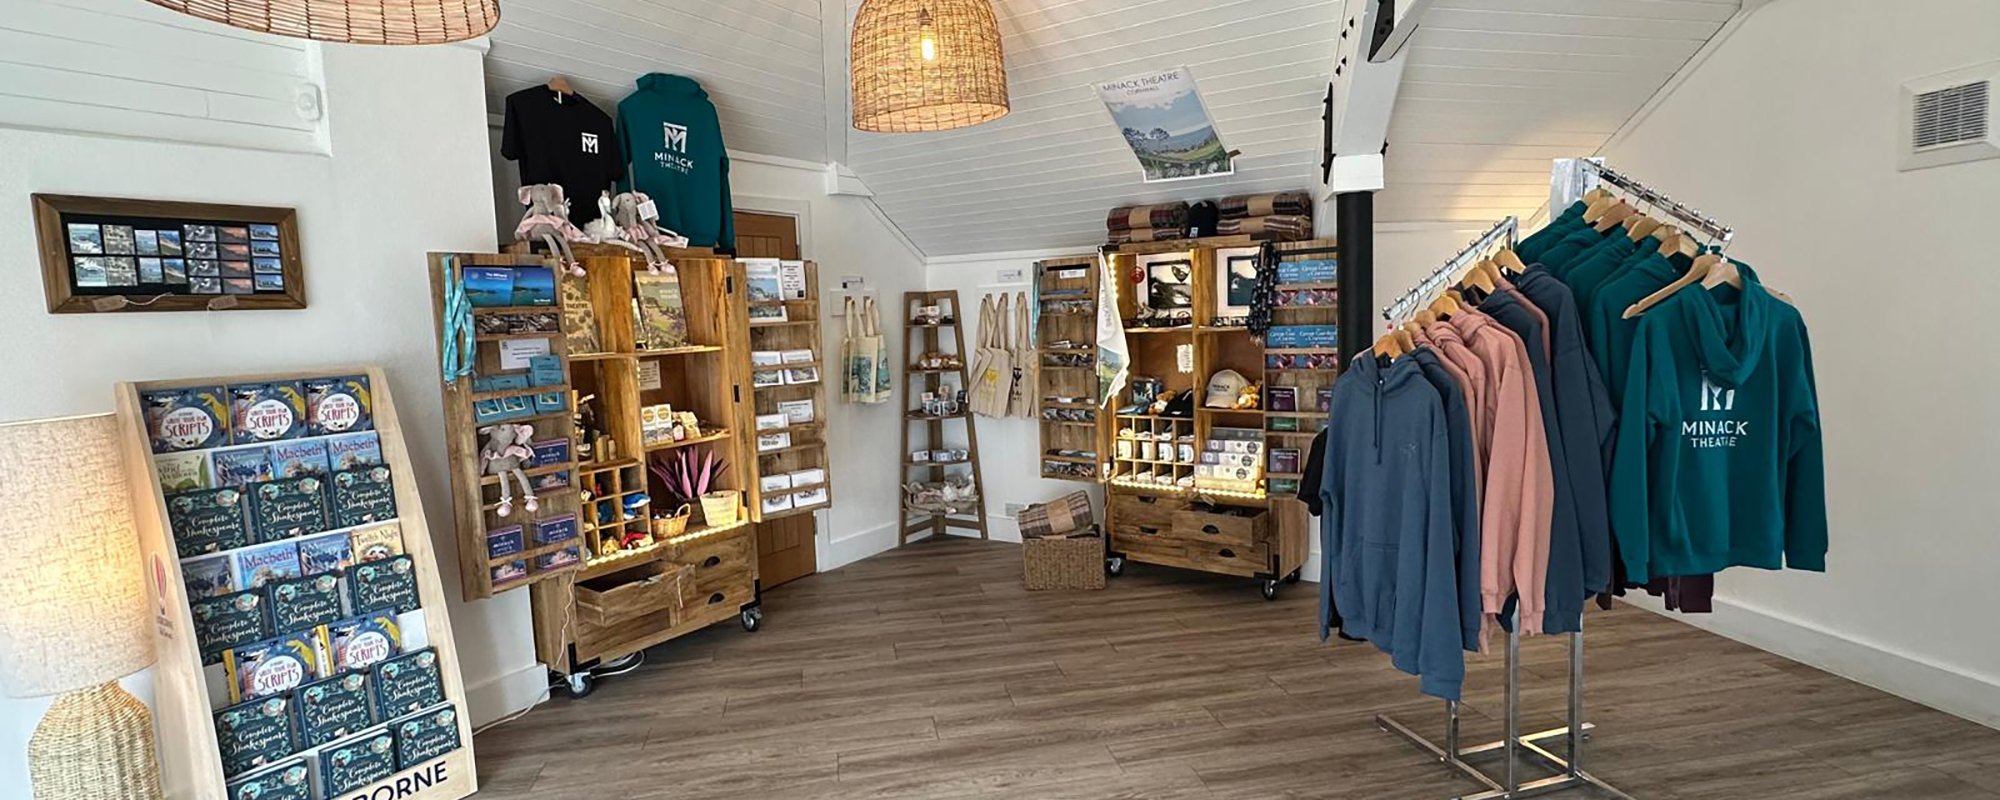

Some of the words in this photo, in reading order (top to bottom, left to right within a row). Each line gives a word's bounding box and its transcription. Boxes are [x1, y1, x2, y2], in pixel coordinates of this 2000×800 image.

[1141, 71, 1180, 86] THEATRE
[654, 151, 694, 169] MINACK
[249, 414, 290, 430] SCRIPTS
[320, 406, 358, 422] SCRIPTS
[164, 422, 210, 438] SCRIPTS
[1681, 420, 1748, 436] MINACK
[277, 446, 322, 459] Macbeth
[333, 440, 375, 454] Macbeth
[244, 550, 294, 568] Macbeth
[349, 644, 387, 664] SCRIPTS
[257, 669, 300, 691] SCRIPTS
